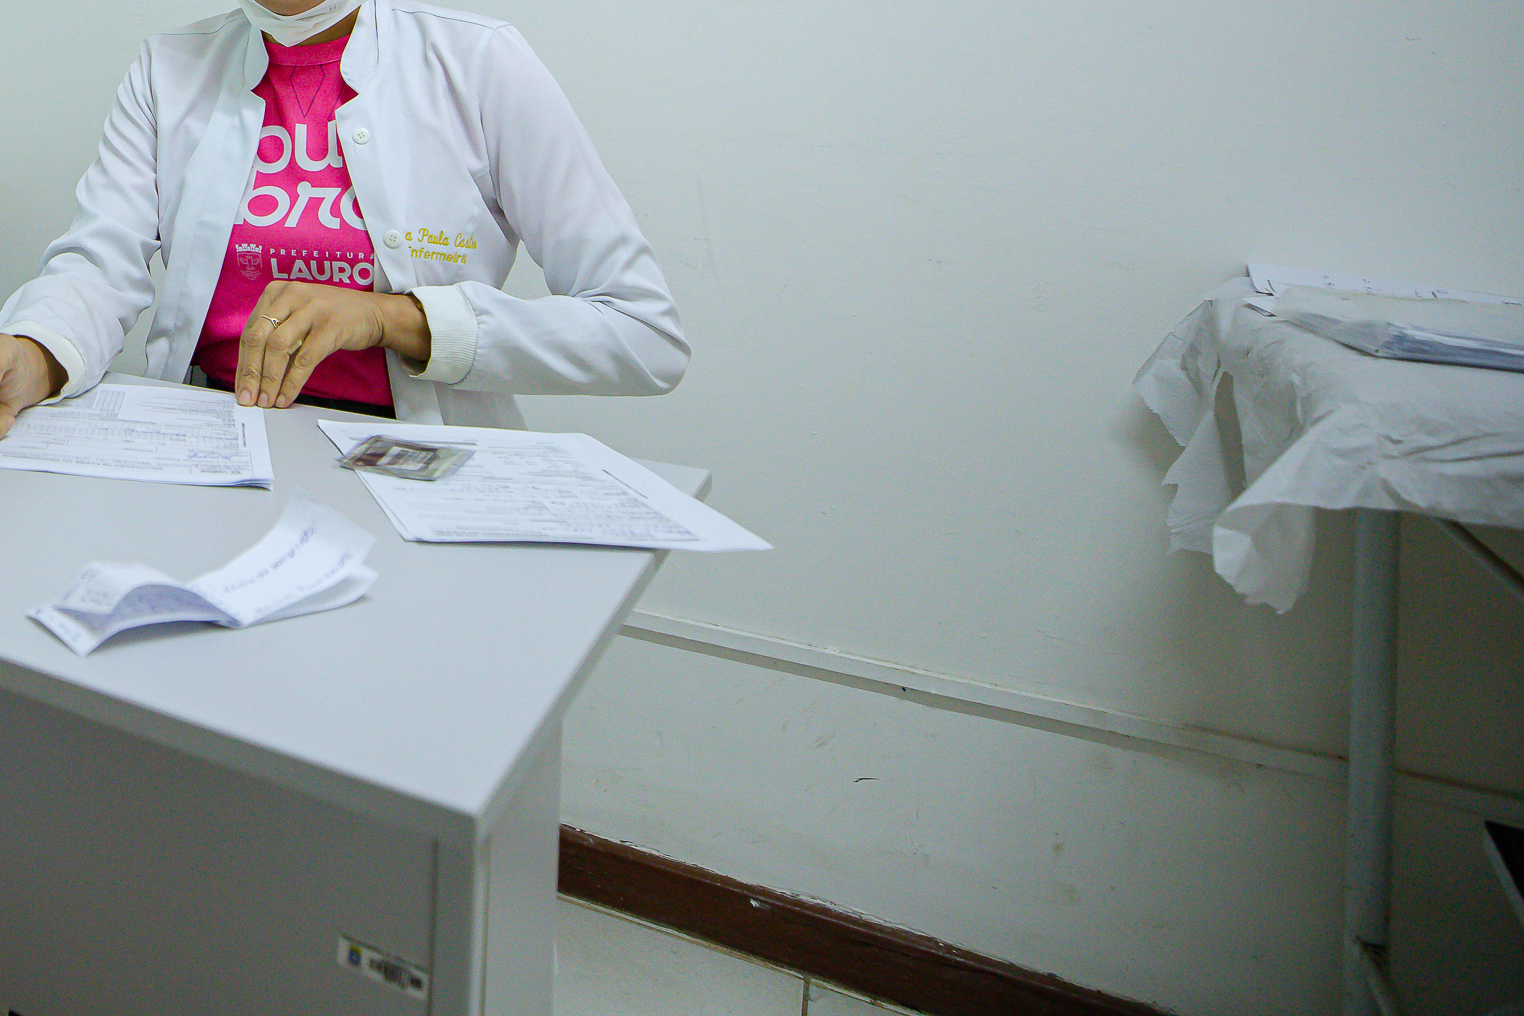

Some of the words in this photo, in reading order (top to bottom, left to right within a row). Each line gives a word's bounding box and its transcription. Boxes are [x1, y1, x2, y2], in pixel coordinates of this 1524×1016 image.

[418, 228, 449, 246] Paula
[409, 246, 466, 264] nfermeira
[271, 258, 374, 285] LAURO
